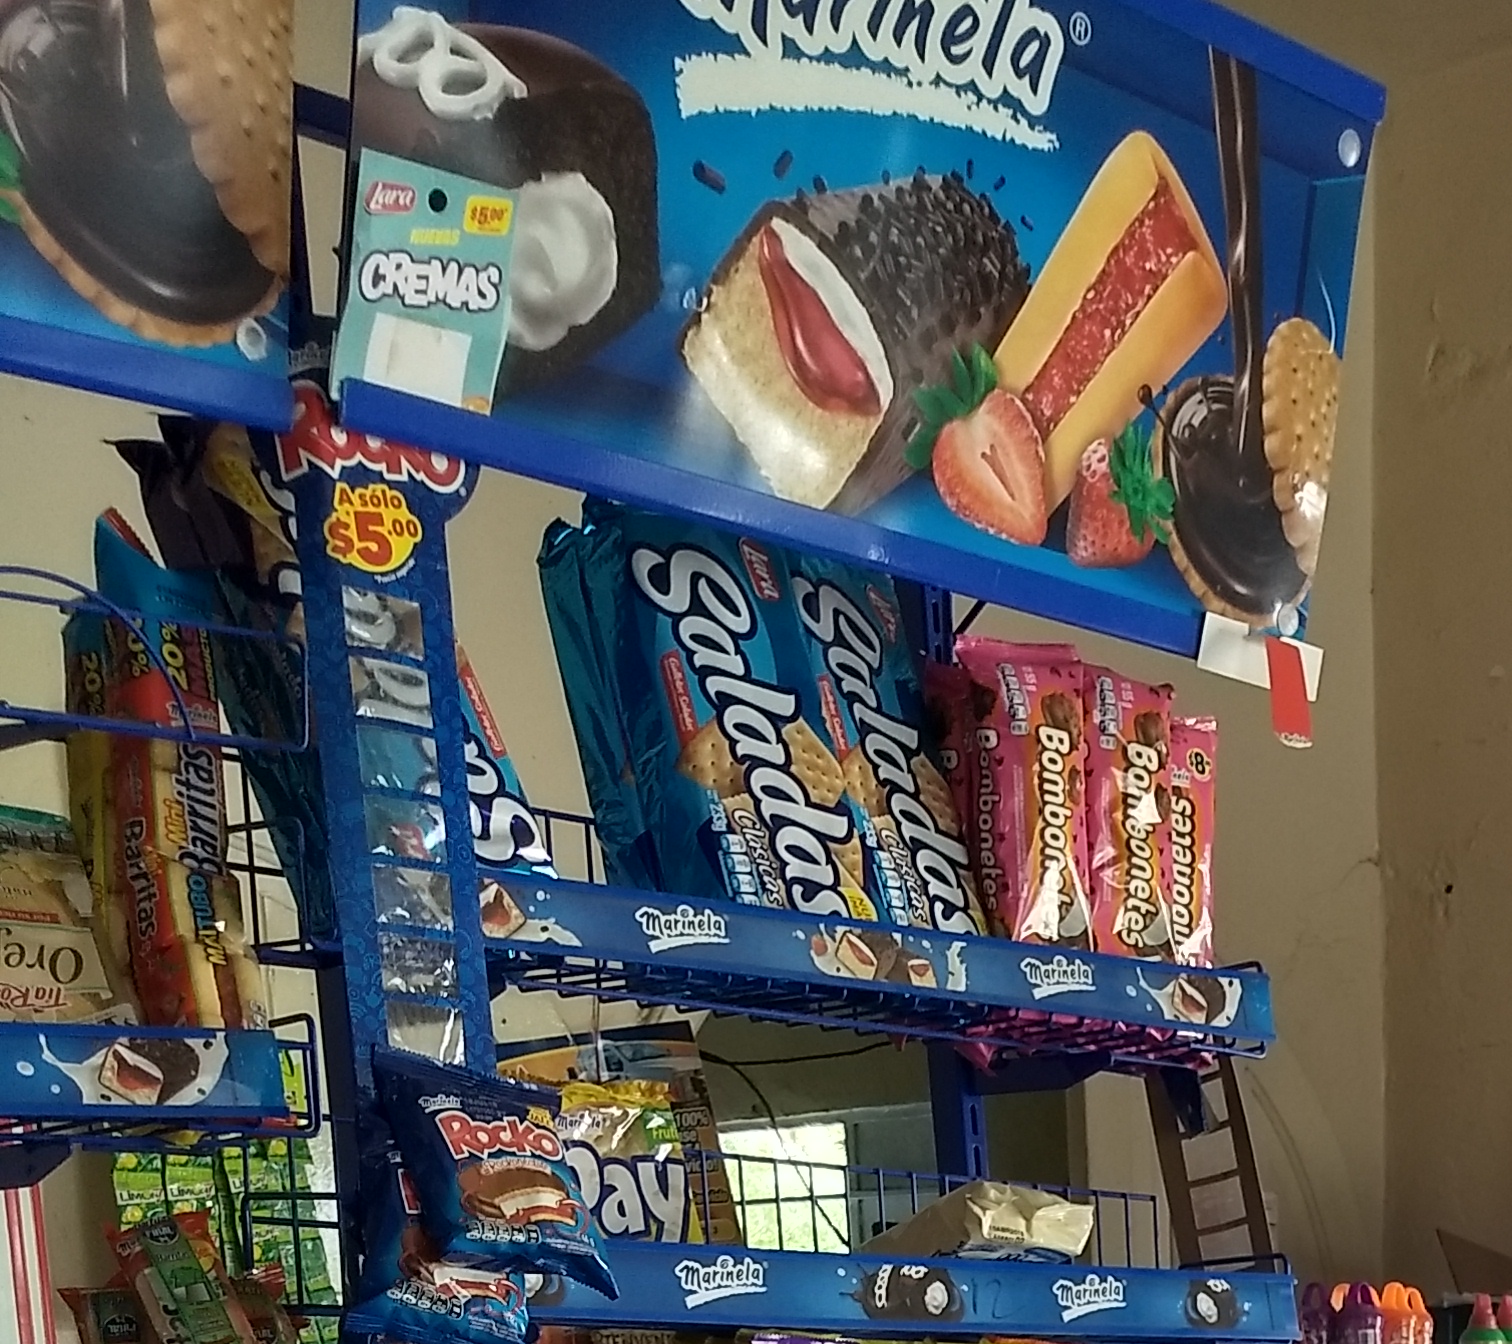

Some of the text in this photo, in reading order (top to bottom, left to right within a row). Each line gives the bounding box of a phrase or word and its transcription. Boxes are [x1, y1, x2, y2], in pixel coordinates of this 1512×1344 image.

[368, 181, 412, 210] Lara
[360, 252, 501, 310] CREMAS
[337, 486, 402, 510] A sólo
[328, 511, 418, 566] $5.00
[743, 541, 779, 598] Lara
[632, 546, 850, 918] Saladas
[791, 576, 977, 932] Saladas
[975, 727, 1005, 912] Bombonetes
[731, 808, 782, 906] Clásicas
[637, 905, 726, 937] Marinela
[1022, 956, 1092, 985] Marinela
[435, 1110, 563, 1161] Rocko
[677, 1258, 764, 1289] Marinela
[1054, 1277, 1125, 1306] Marinela
